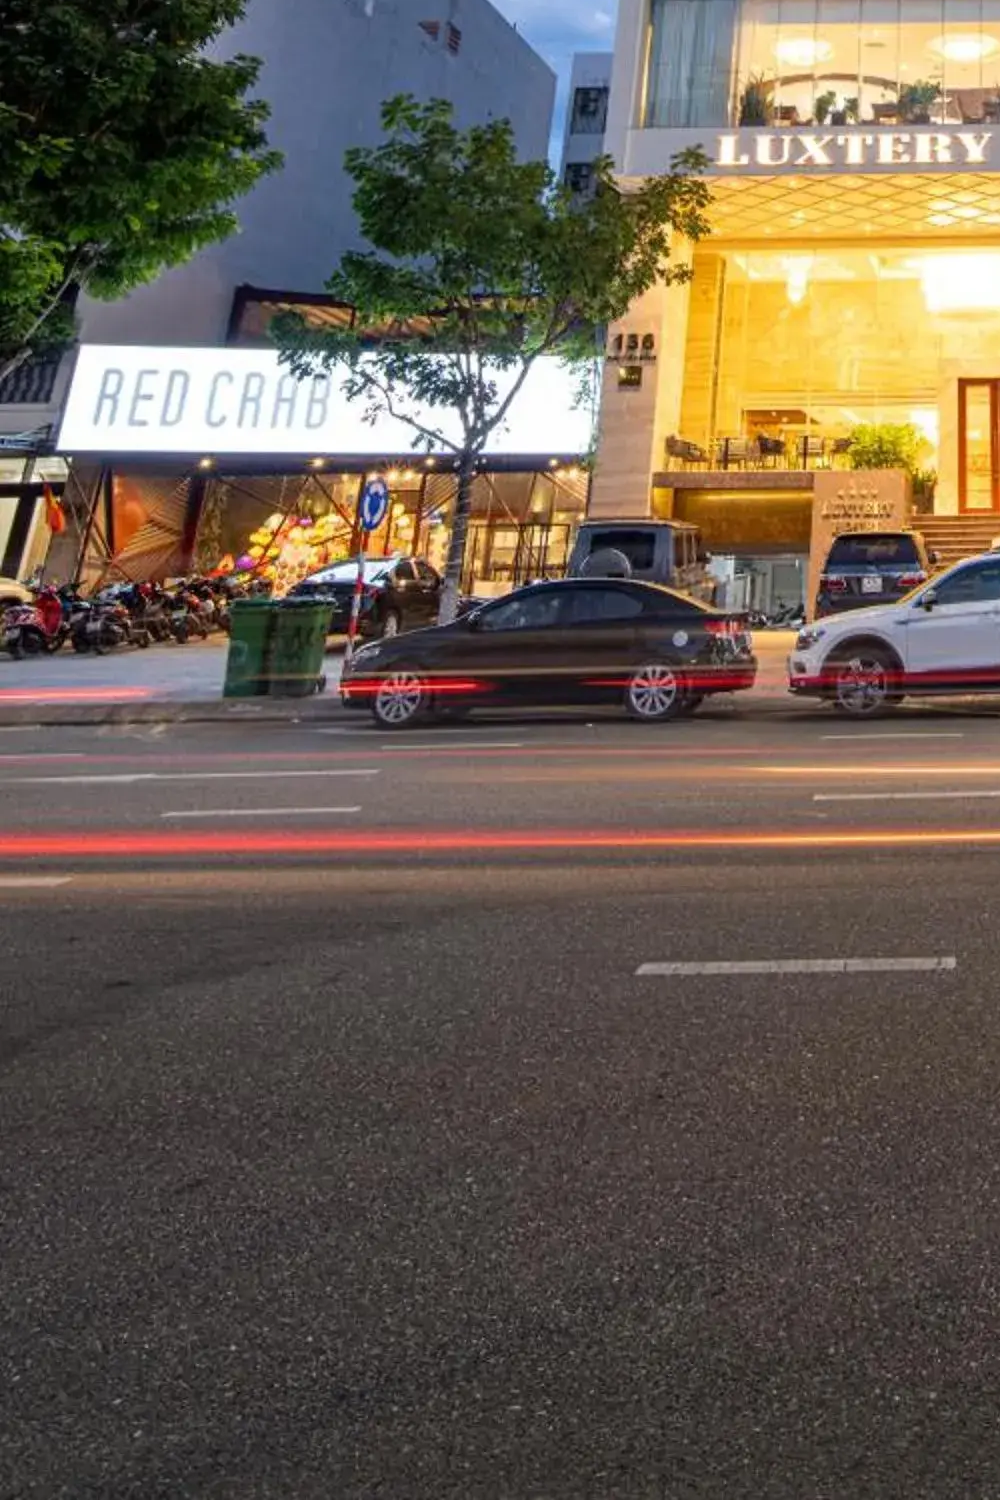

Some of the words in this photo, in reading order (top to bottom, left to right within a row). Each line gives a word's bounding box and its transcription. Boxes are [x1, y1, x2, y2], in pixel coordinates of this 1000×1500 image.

[716, 132, 992, 165] LUXTERY
[93, 368, 190, 427] RED
[204, 370, 332, 429] CRAB
